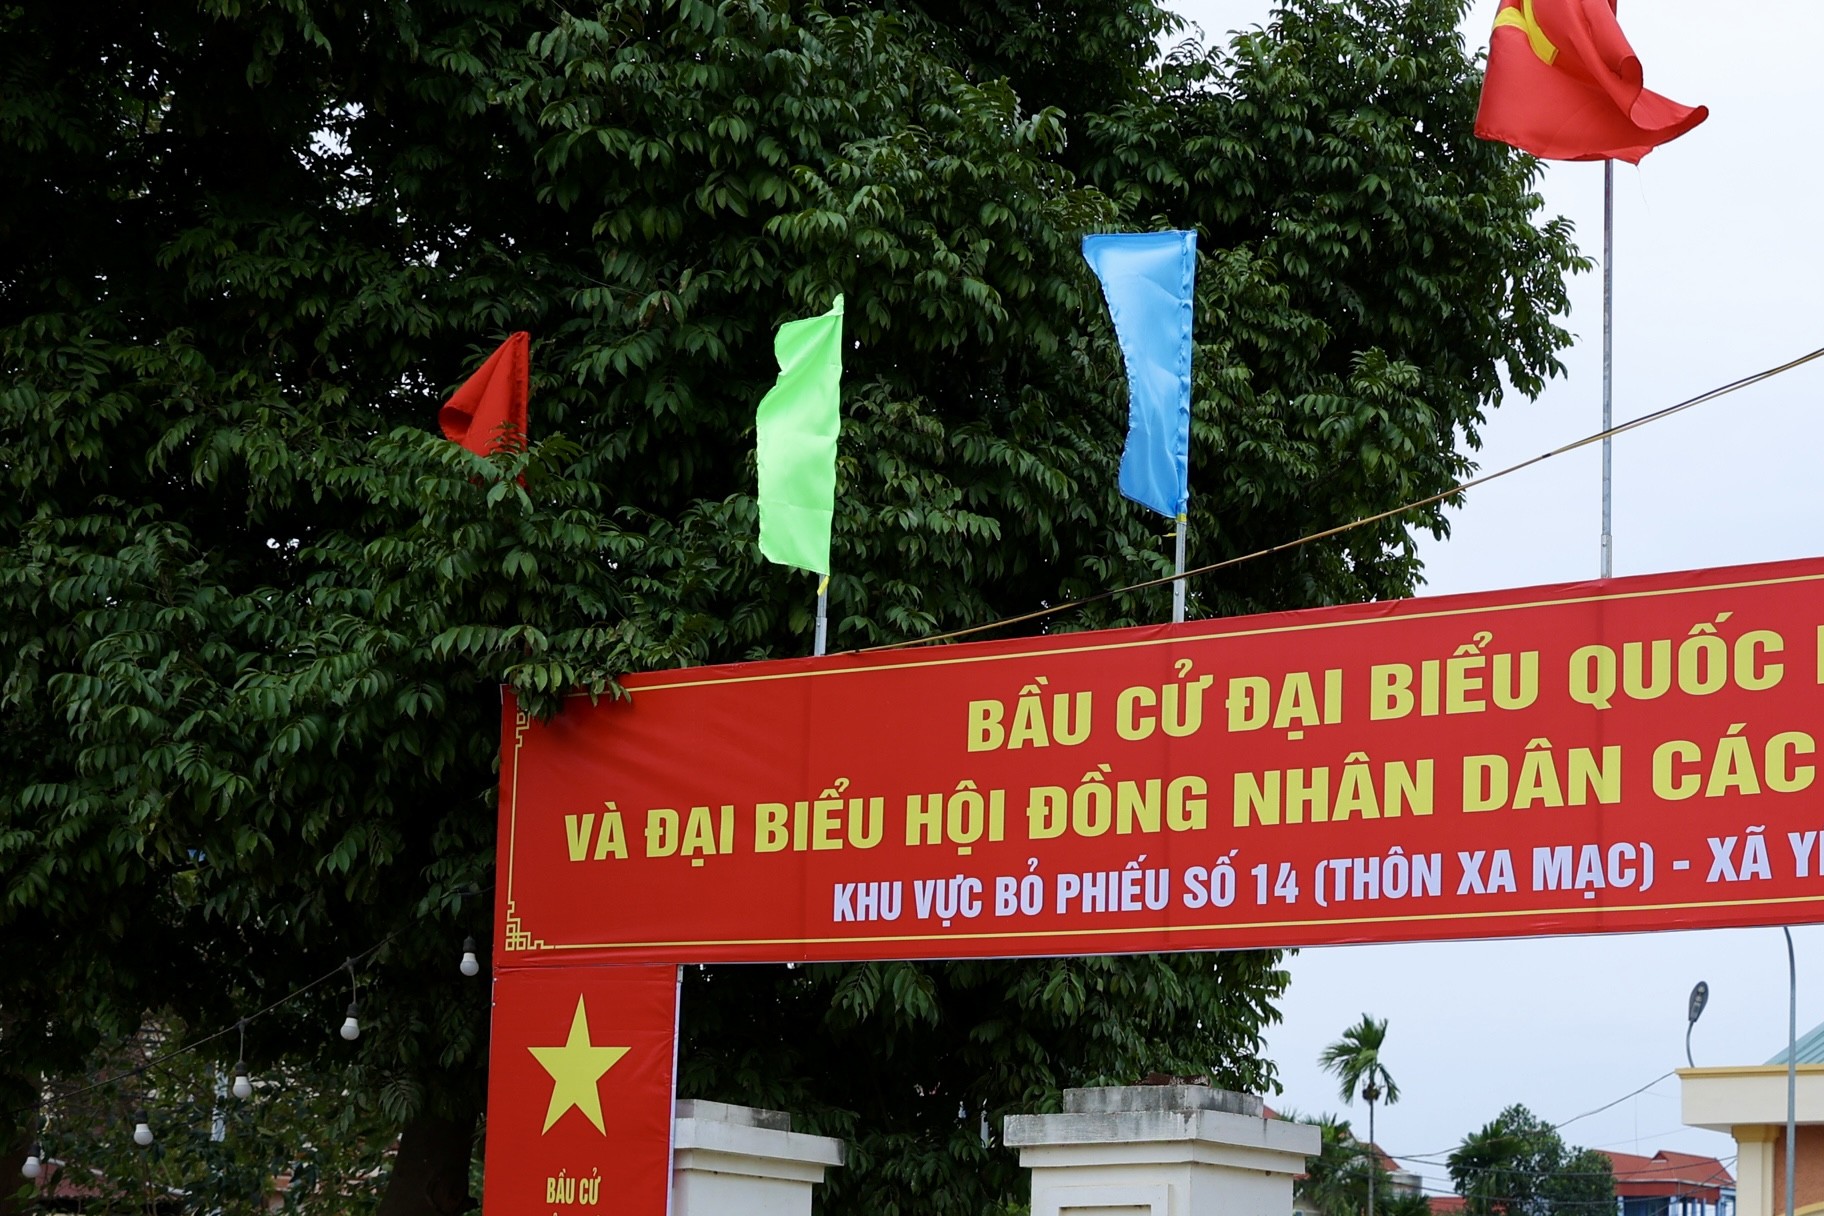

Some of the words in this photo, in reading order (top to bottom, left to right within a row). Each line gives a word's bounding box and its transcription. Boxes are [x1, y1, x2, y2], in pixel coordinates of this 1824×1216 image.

[968, 676, 1092, 752] BẦU
[1116, 659, 1213, 740] CỬ
[1226, 669, 1342, 740] ĐẠI
[1370, 631, 1538, 720] BIỂU
[1569, 612, 1784, 710] QUỐC
[565, 802, 628, 861] VÀ
[645, 805, 734, 866] ĐẠI
[755, 778, 884, 852] BIỂU
[906, 780, 1005, 855] HỘI
[1027, 764, 1207, 839] ĐỒNG
[1234, 752, 1433, 827] NHÂN
[1463, 738, 1621, 812] DÂN
[1653, 723, 1815, 800] CÁC
[834, 882, 901, 921] KHU
[914, 875, 982, 926] VỰC
[996, 858, 1043, 916] BỎ
[1057, 855, 1169, 913] PHIẾU
[1184, 850, 1238, 908] SỐ
[1252, 863, 1298, 904] 14
[1315, 846, 1441, 907] (THÔN
[1457, 850, 1516, 894] XA
[1533, 843, 1653, 898] MẠC)
[1707, 825, 1771, 882] XÃ
[546, 1168, 575, 1204] BẦU
[579, 1167, 601, 1205] CỬ
